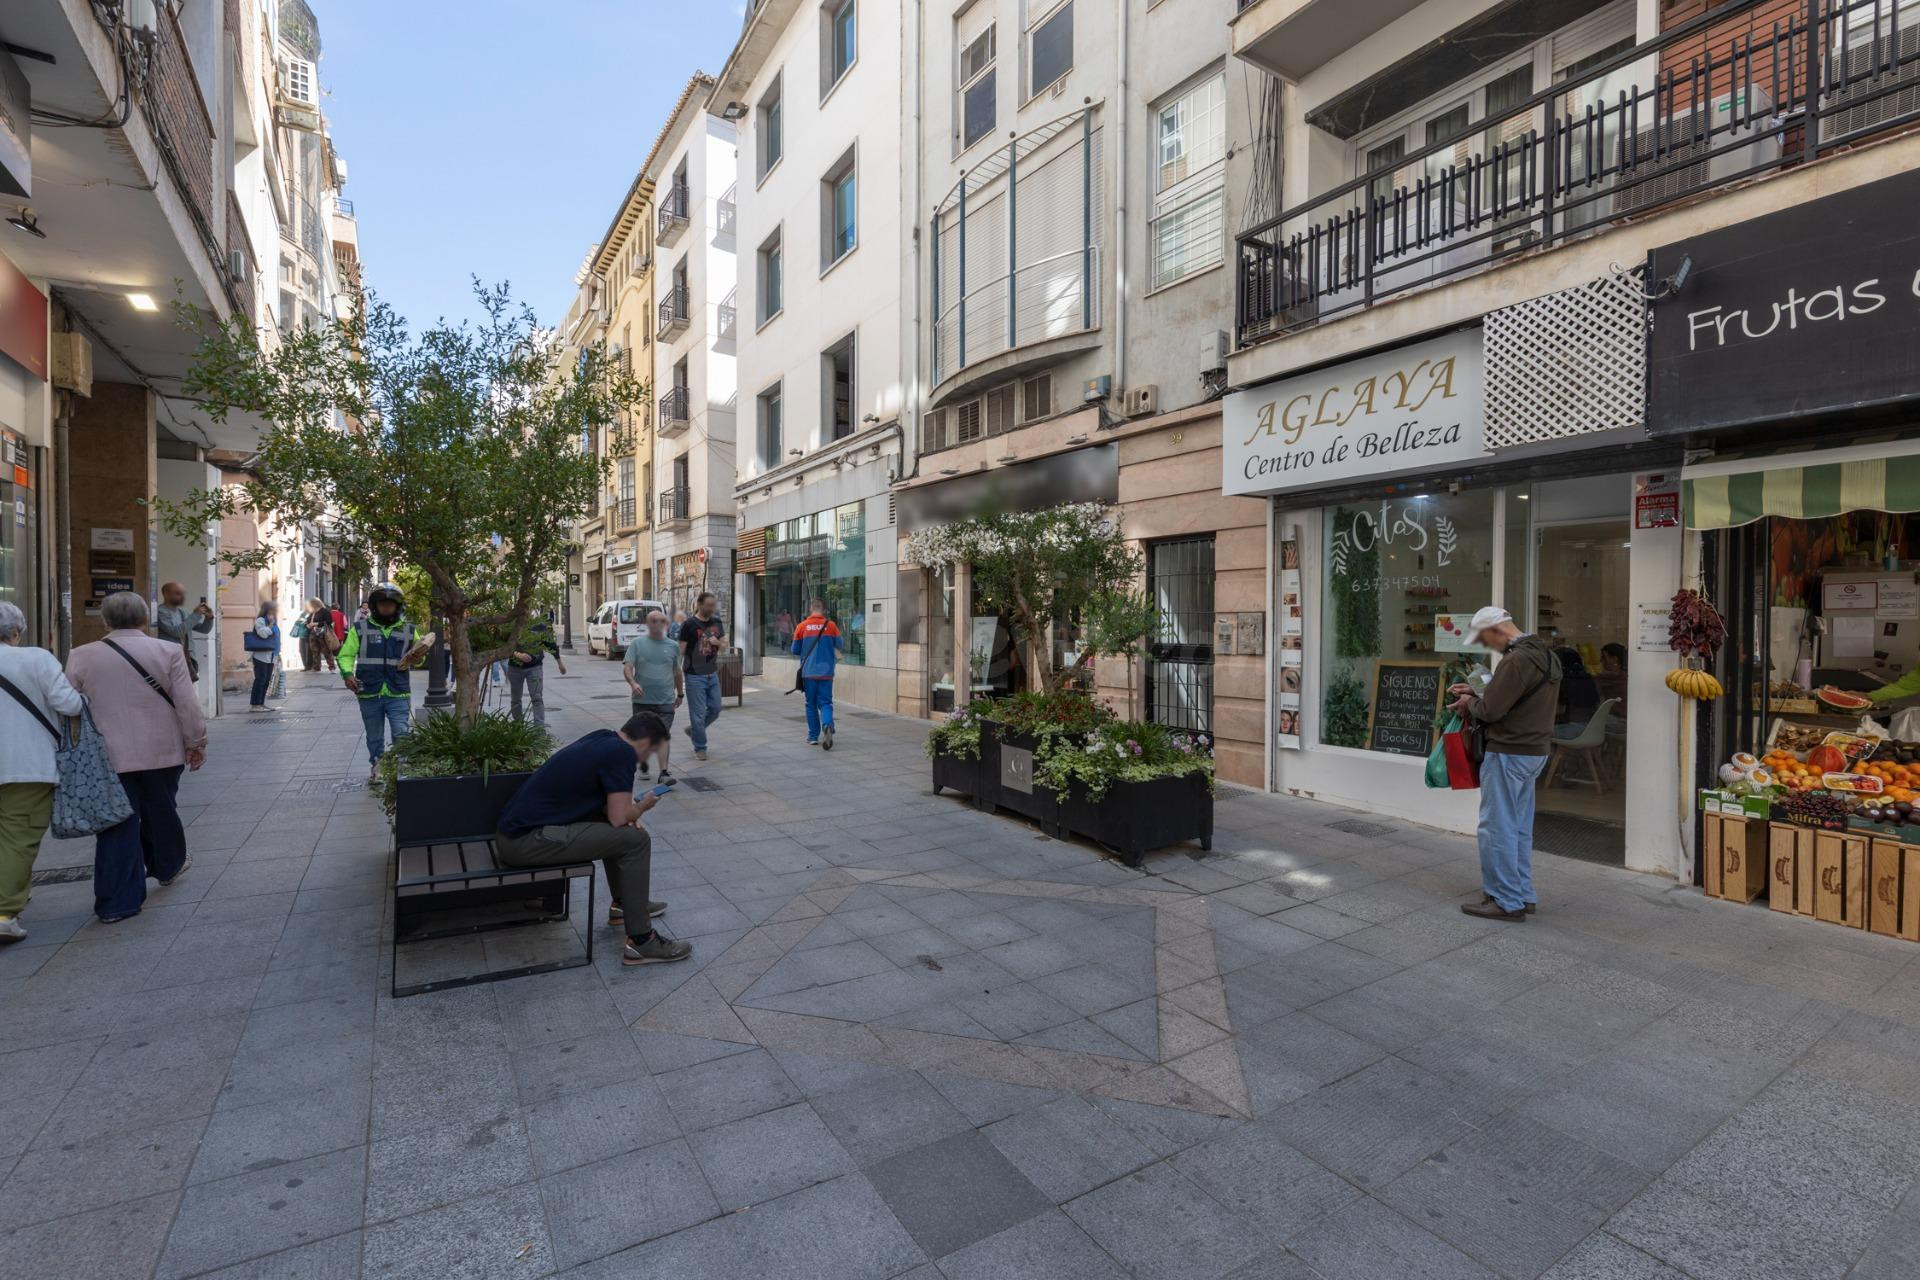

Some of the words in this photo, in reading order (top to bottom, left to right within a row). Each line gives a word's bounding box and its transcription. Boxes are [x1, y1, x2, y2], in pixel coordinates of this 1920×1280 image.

[1687, 278, 1886, 351] Frutas
[1243, 355, 1458, 446] AGLAYA
[1244, 450, 1315, 480] Centro
[1322, 435, 1349, 465] de
[1356, 420, 1462, 459] Belleza
[1638, 495, 1676, 506] Alarma
[1381, 672, 1437, 690] SÍGUENOS
[1402, 690, 1430, 700] REDES
[1786, 812, 1822, 825] Mifra
